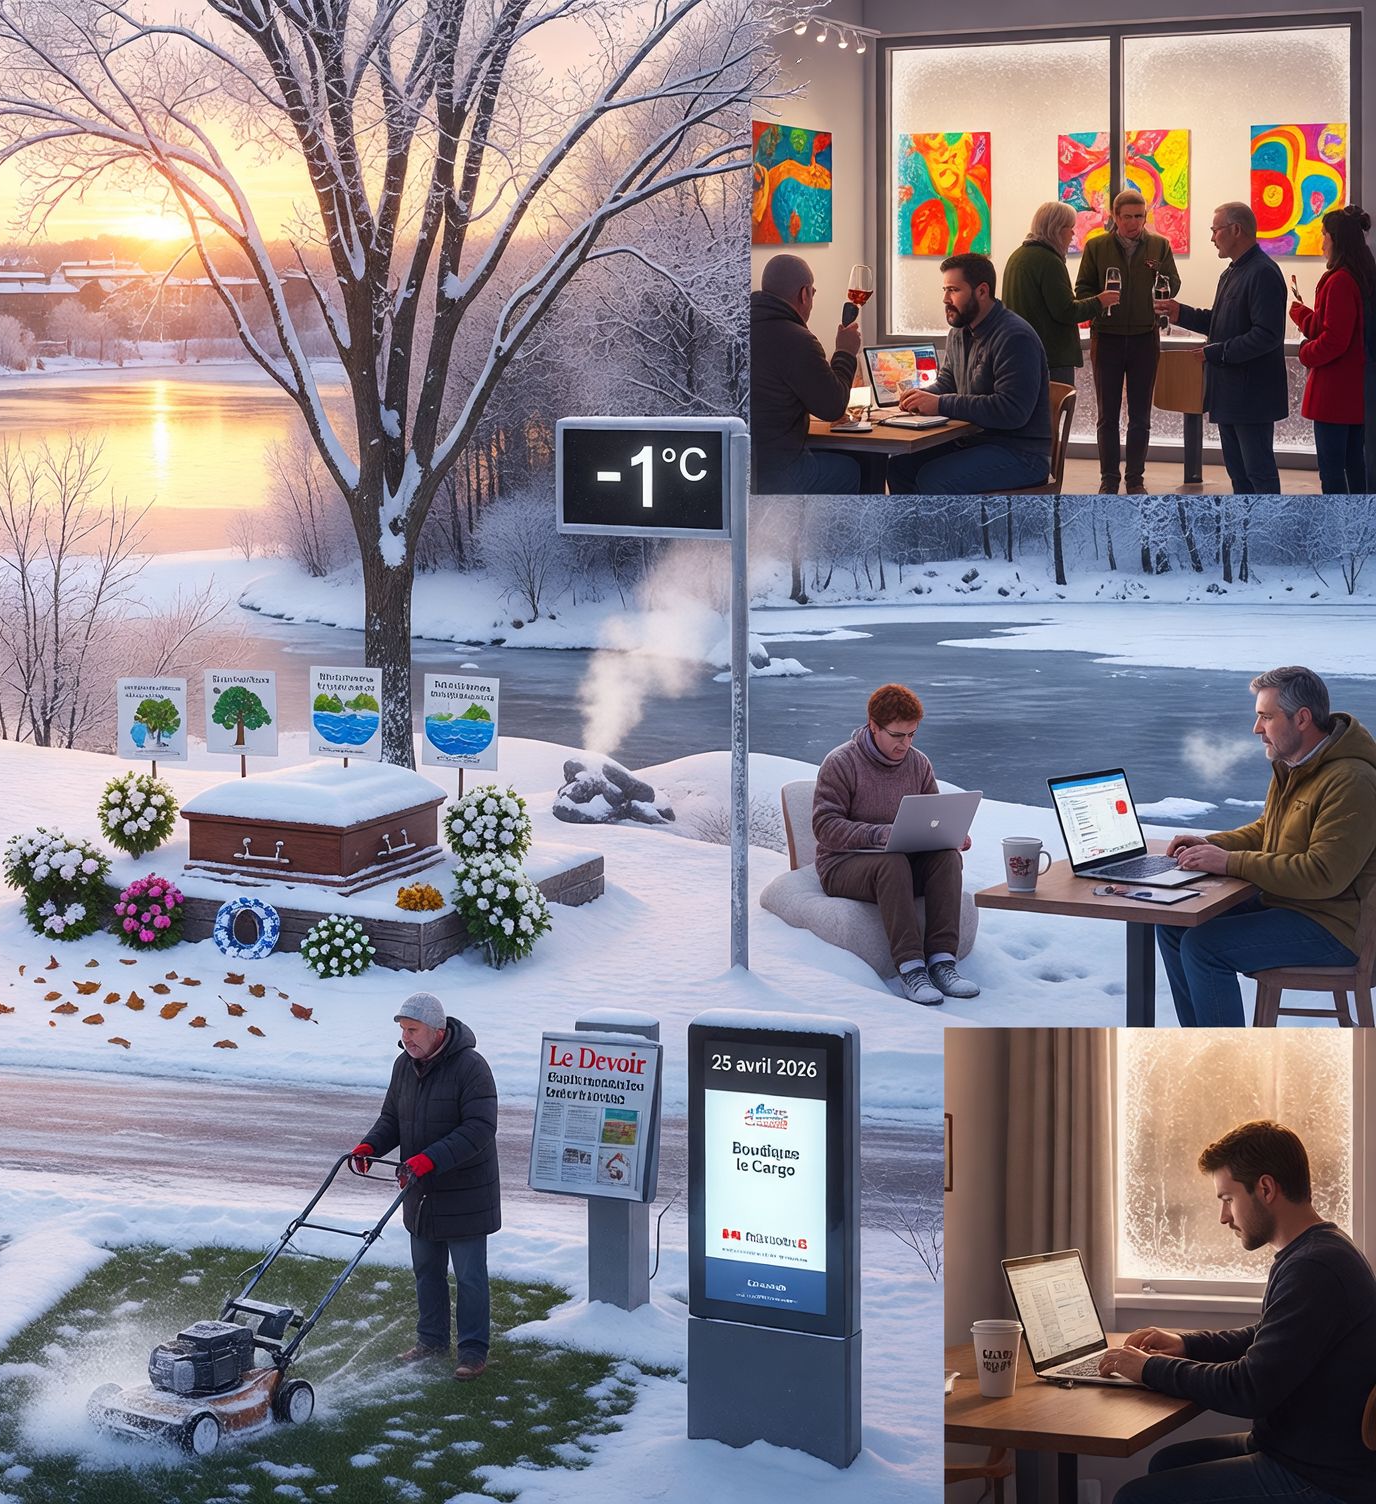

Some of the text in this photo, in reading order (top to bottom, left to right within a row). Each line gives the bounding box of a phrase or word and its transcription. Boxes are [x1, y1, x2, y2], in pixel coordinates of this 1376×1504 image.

[548, 1045, 647, 1075] Le Devoir
[711, 1054, 817, 1078] 25 avril 2026
[736, 1158, 796, 1179] le Cargo
